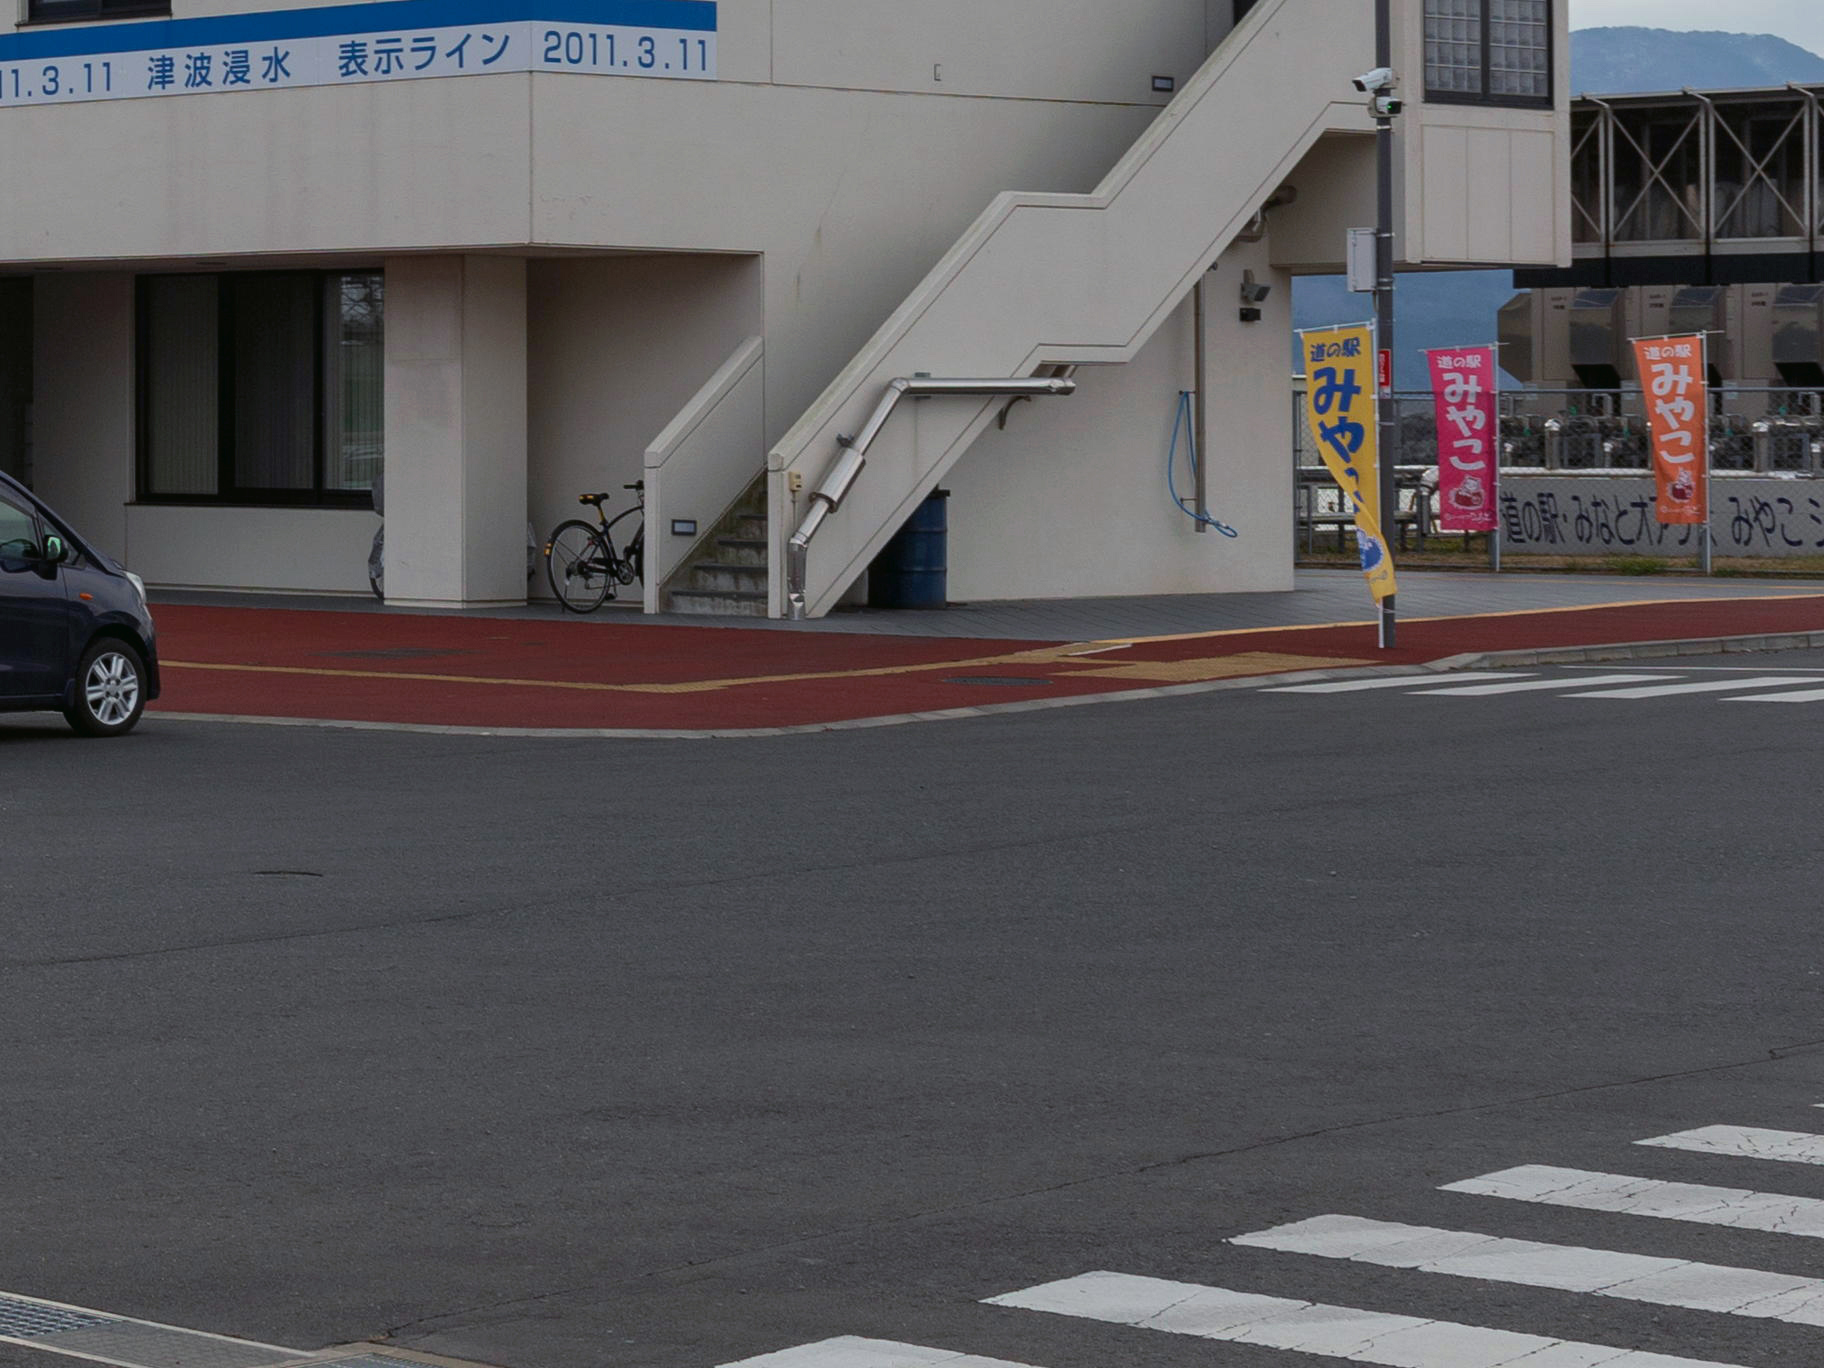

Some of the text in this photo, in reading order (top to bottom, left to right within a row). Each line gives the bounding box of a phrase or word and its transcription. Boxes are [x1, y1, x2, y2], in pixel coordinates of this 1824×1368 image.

[147, 47, 292, 91] 津波浸水
[338, 33, 511, 78] 表示ライン
[543, 29, 710, 72] 2011.3.11
[1309, 336, 1361, 362] 道の駅
[1436, 354, 1483, 370] 道の駅
[1643, 343, 1693, 361] 道の駅
[1442, 372, 1487, 471] みやこ
[1651, 362, 1696, 464] みやこ
[1728, 494, 1802, 547] みやこ
